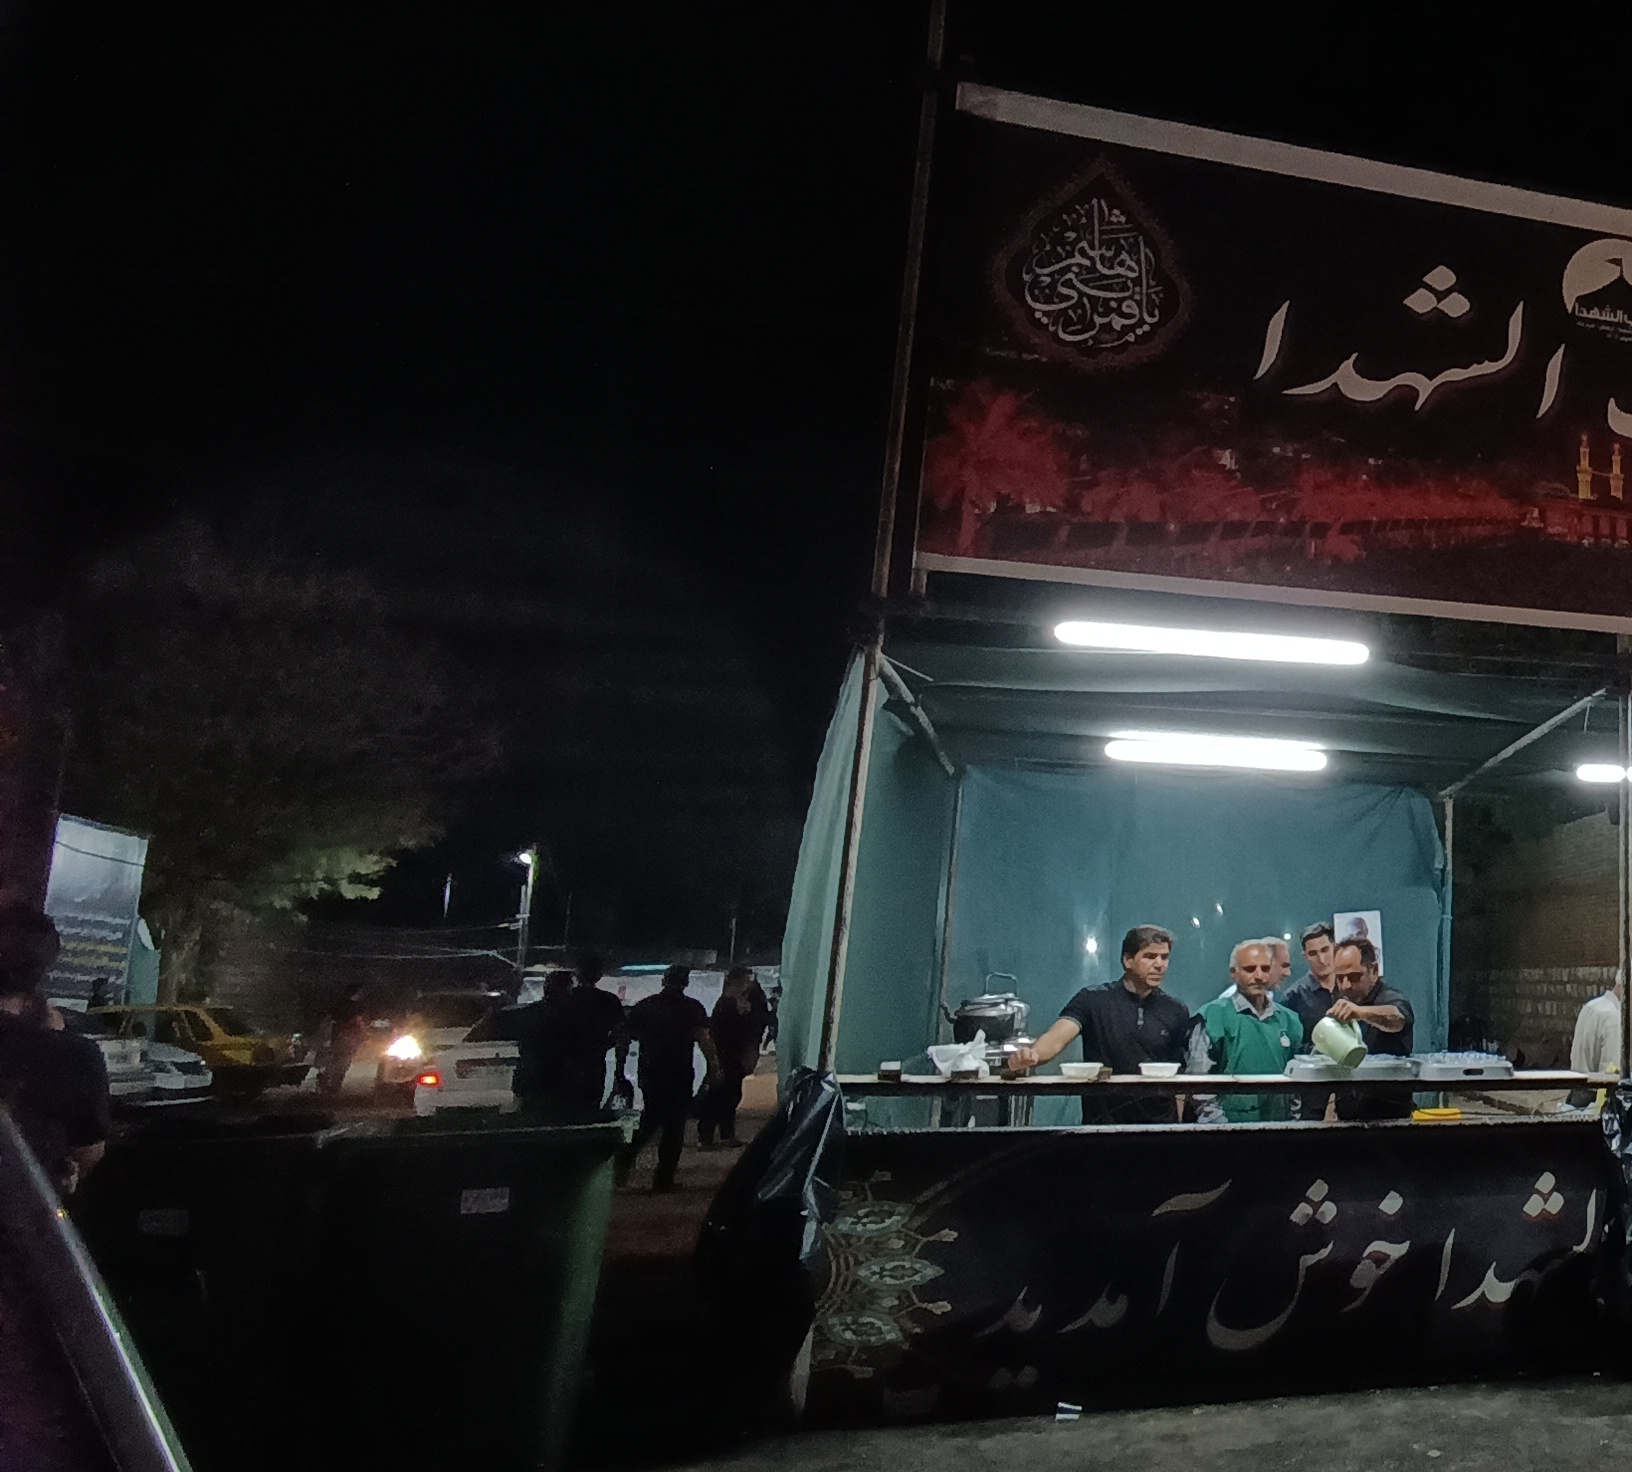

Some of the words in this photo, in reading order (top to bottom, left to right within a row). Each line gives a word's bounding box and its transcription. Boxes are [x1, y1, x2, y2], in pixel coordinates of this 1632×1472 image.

[1253, 264, 1566, 420] الشهدا
[1574, 302, 1623, 323] الشهدا
[974, 1178, 1233, 1389] آمدید
[1206, 1178, 1412, 1350] خوش
[1434, 1171, 1597, 1310] لشهدا
